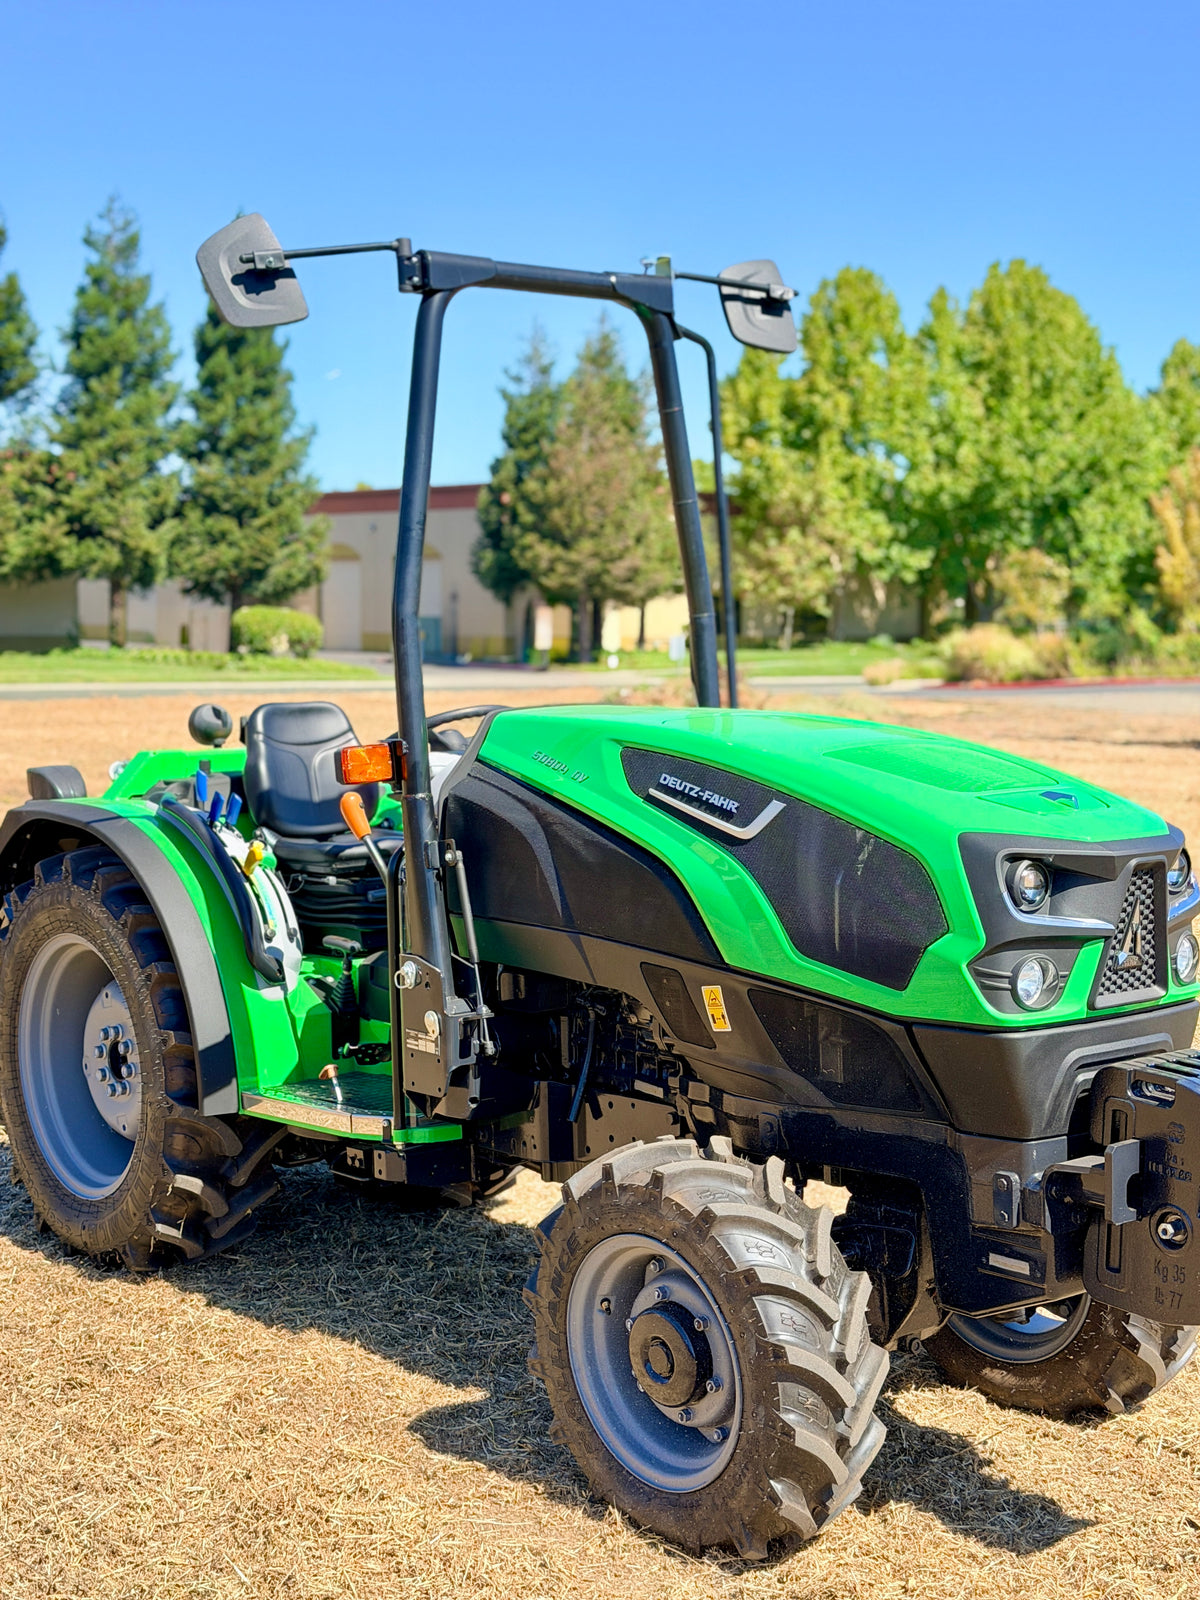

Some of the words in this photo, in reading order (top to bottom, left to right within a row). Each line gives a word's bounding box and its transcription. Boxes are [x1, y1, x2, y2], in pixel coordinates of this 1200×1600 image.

[659, 773, 740, 814] DEUTZ-FAHR
[1153, 1258, 1169, 1284] Kg
[1172, 1264, 1186, 1284] 35
[1169, 1290, 1183, 1310] 77
